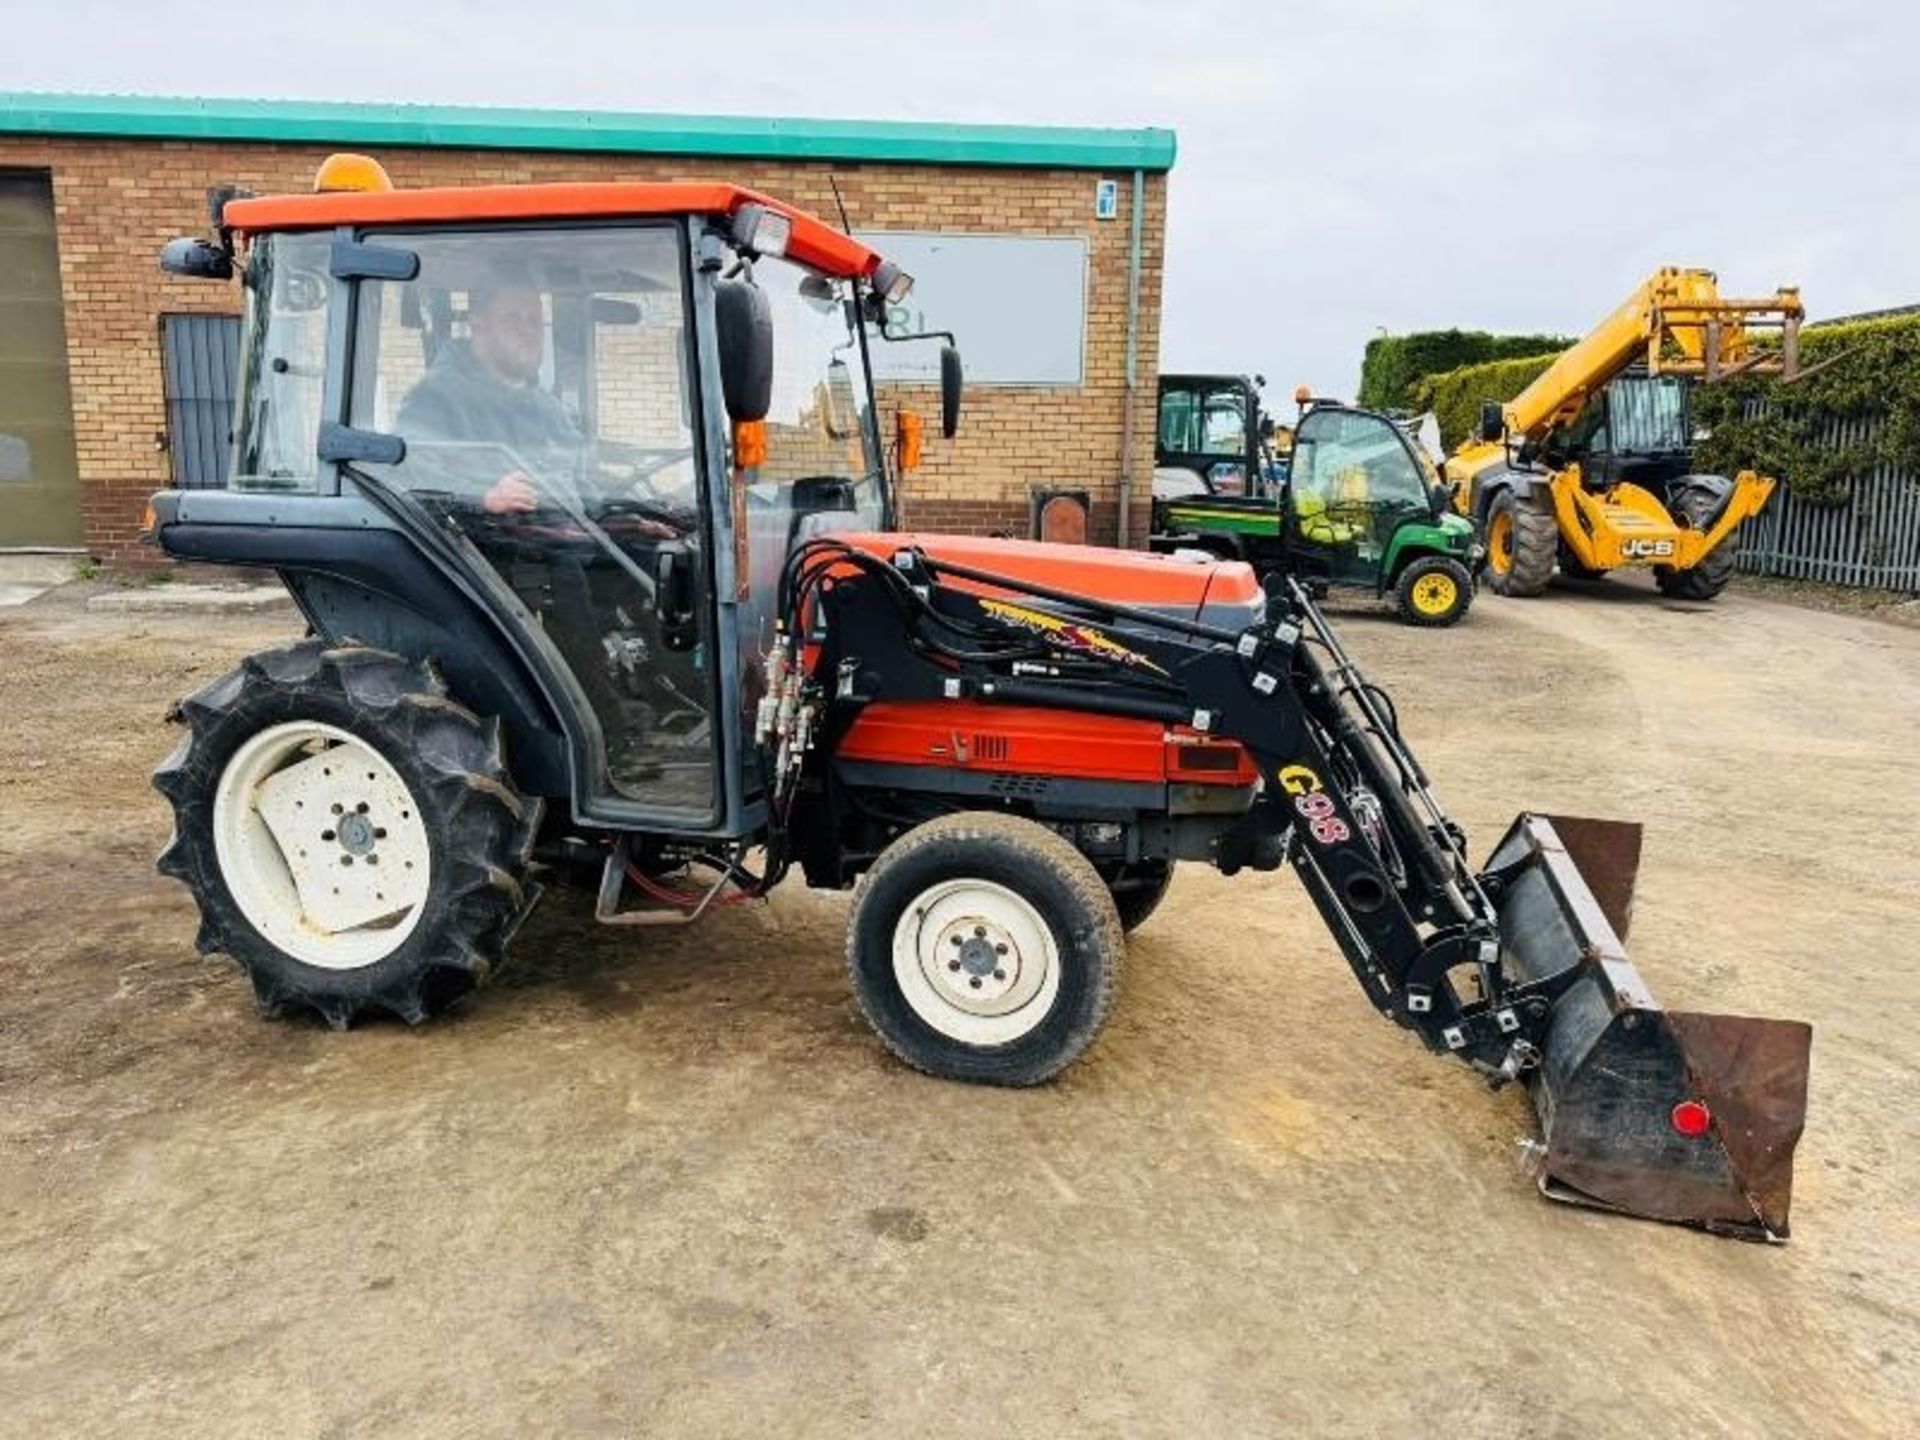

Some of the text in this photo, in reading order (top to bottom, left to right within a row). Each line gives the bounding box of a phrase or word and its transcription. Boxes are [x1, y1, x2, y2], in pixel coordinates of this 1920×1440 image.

[870, 307, 924, 337] RI
[1622, 539, 1673, 556] JCB
[1279, 765, 1349, 843] G98
